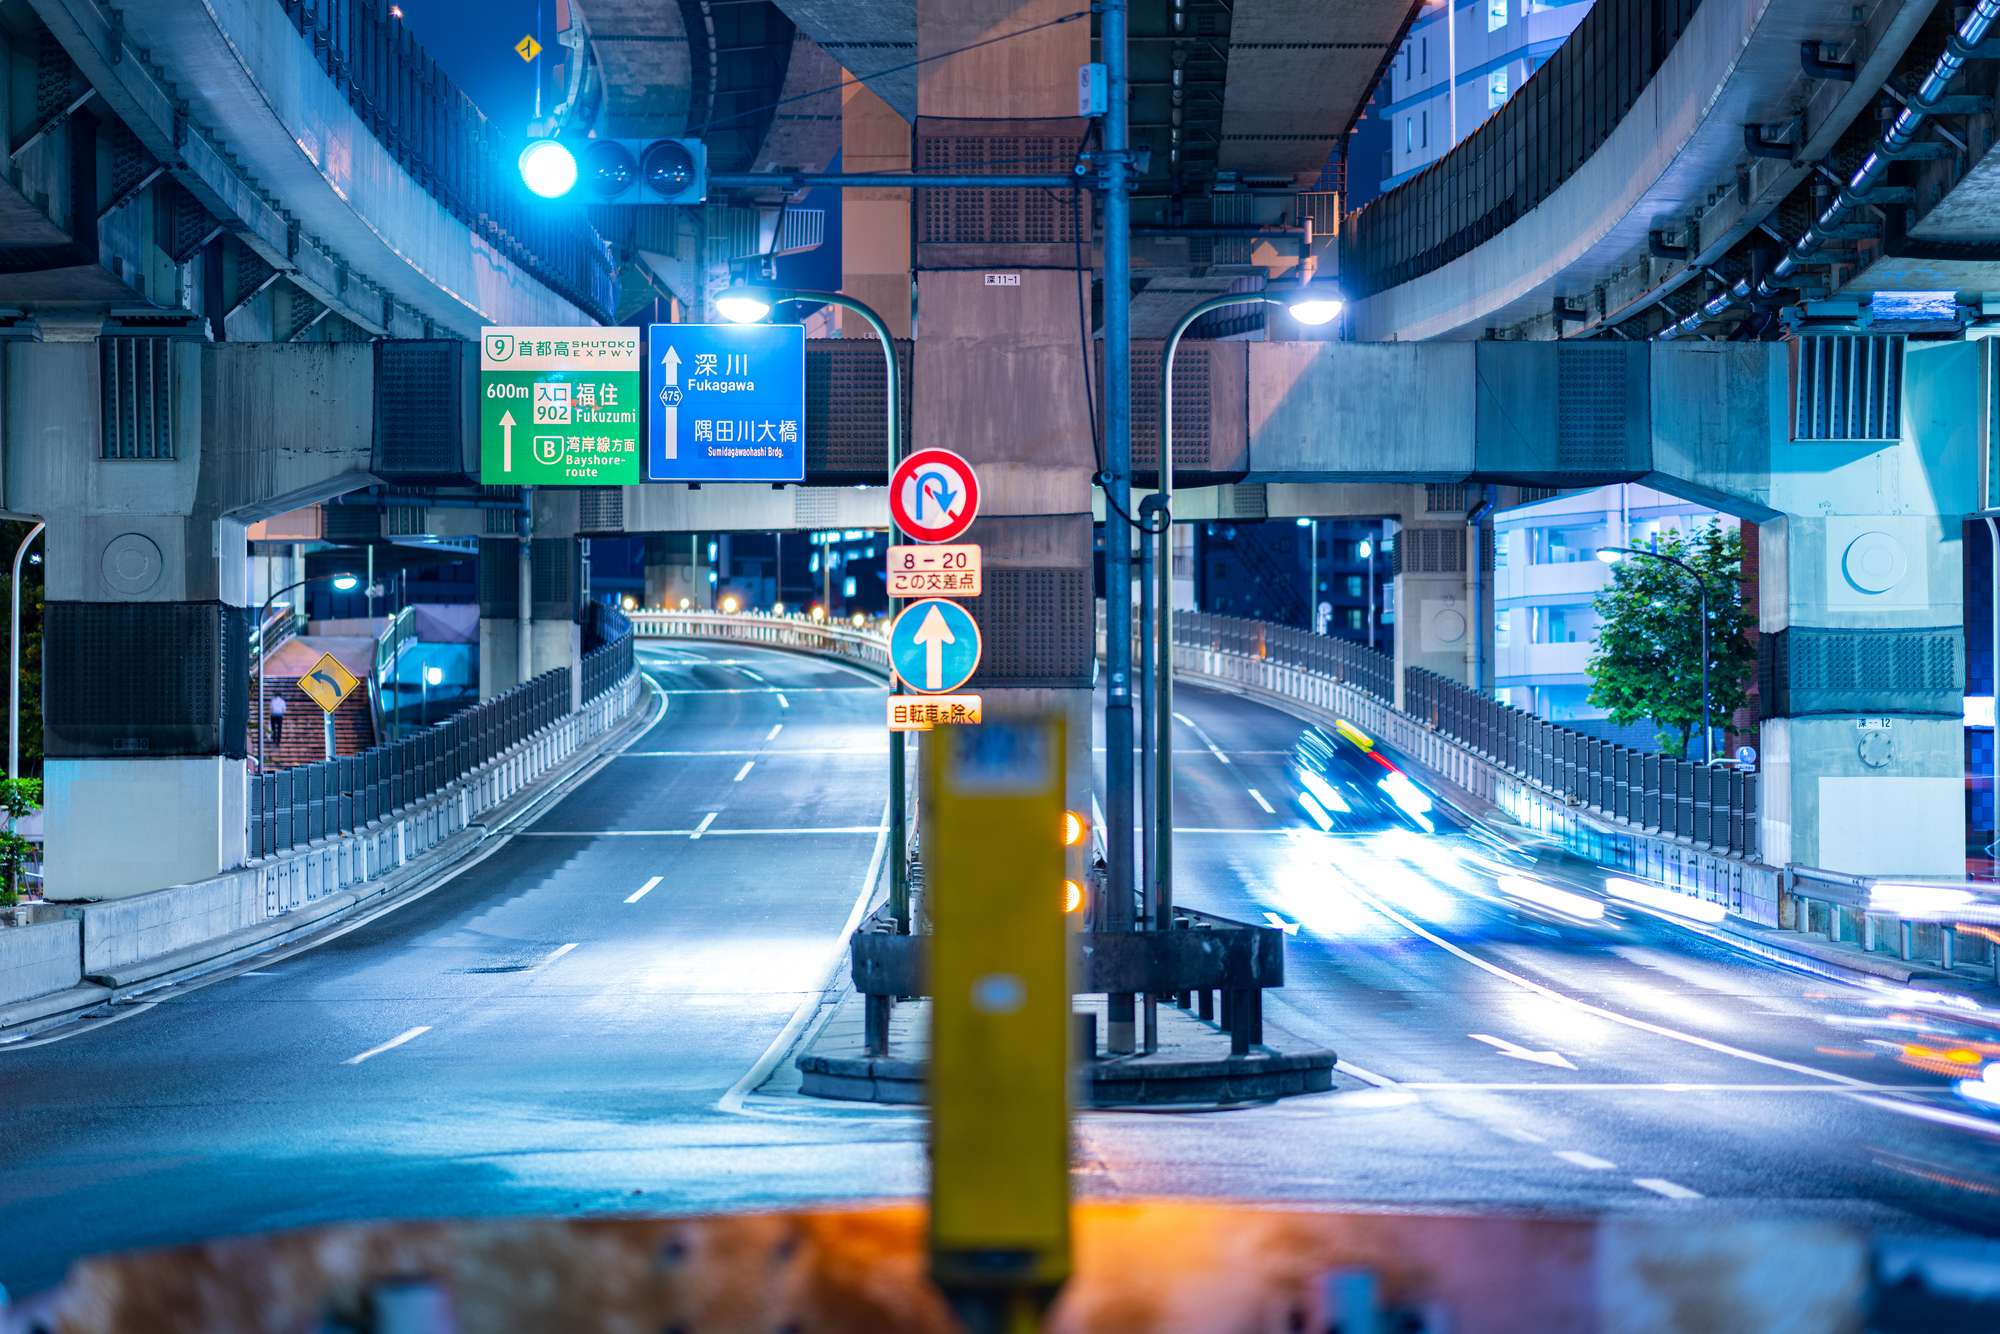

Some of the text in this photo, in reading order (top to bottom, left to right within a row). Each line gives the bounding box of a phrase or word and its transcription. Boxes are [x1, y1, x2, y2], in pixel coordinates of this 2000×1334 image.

[495, 340, 505, 356] 9
[518, 341, 570, 357] 首都高
[694, 353, 748, 376] 深川
[486, 384, 529, 398] 600m
[537, 386, 567, 401] 入口
[687, 379, 755, 393] Fukagawa
[576, 383, 619, 406] 福住
[662, 390, 680, 402] 475
[537, 406, 568, 420] 902
[576, 409, 636, 423] Fukuzumi
[694, 420, 798, 442] 隅田川大橋
[543, 440, 556, 458] B
[566, 436, 635, 453] 湾岸線方面
[566, 455, 626, 467] Bayshore-
[566, 468, 598, 477] route
[896, 574, 975, 590] この交差点
[894, 704, 976, 724] 自転車を除く
